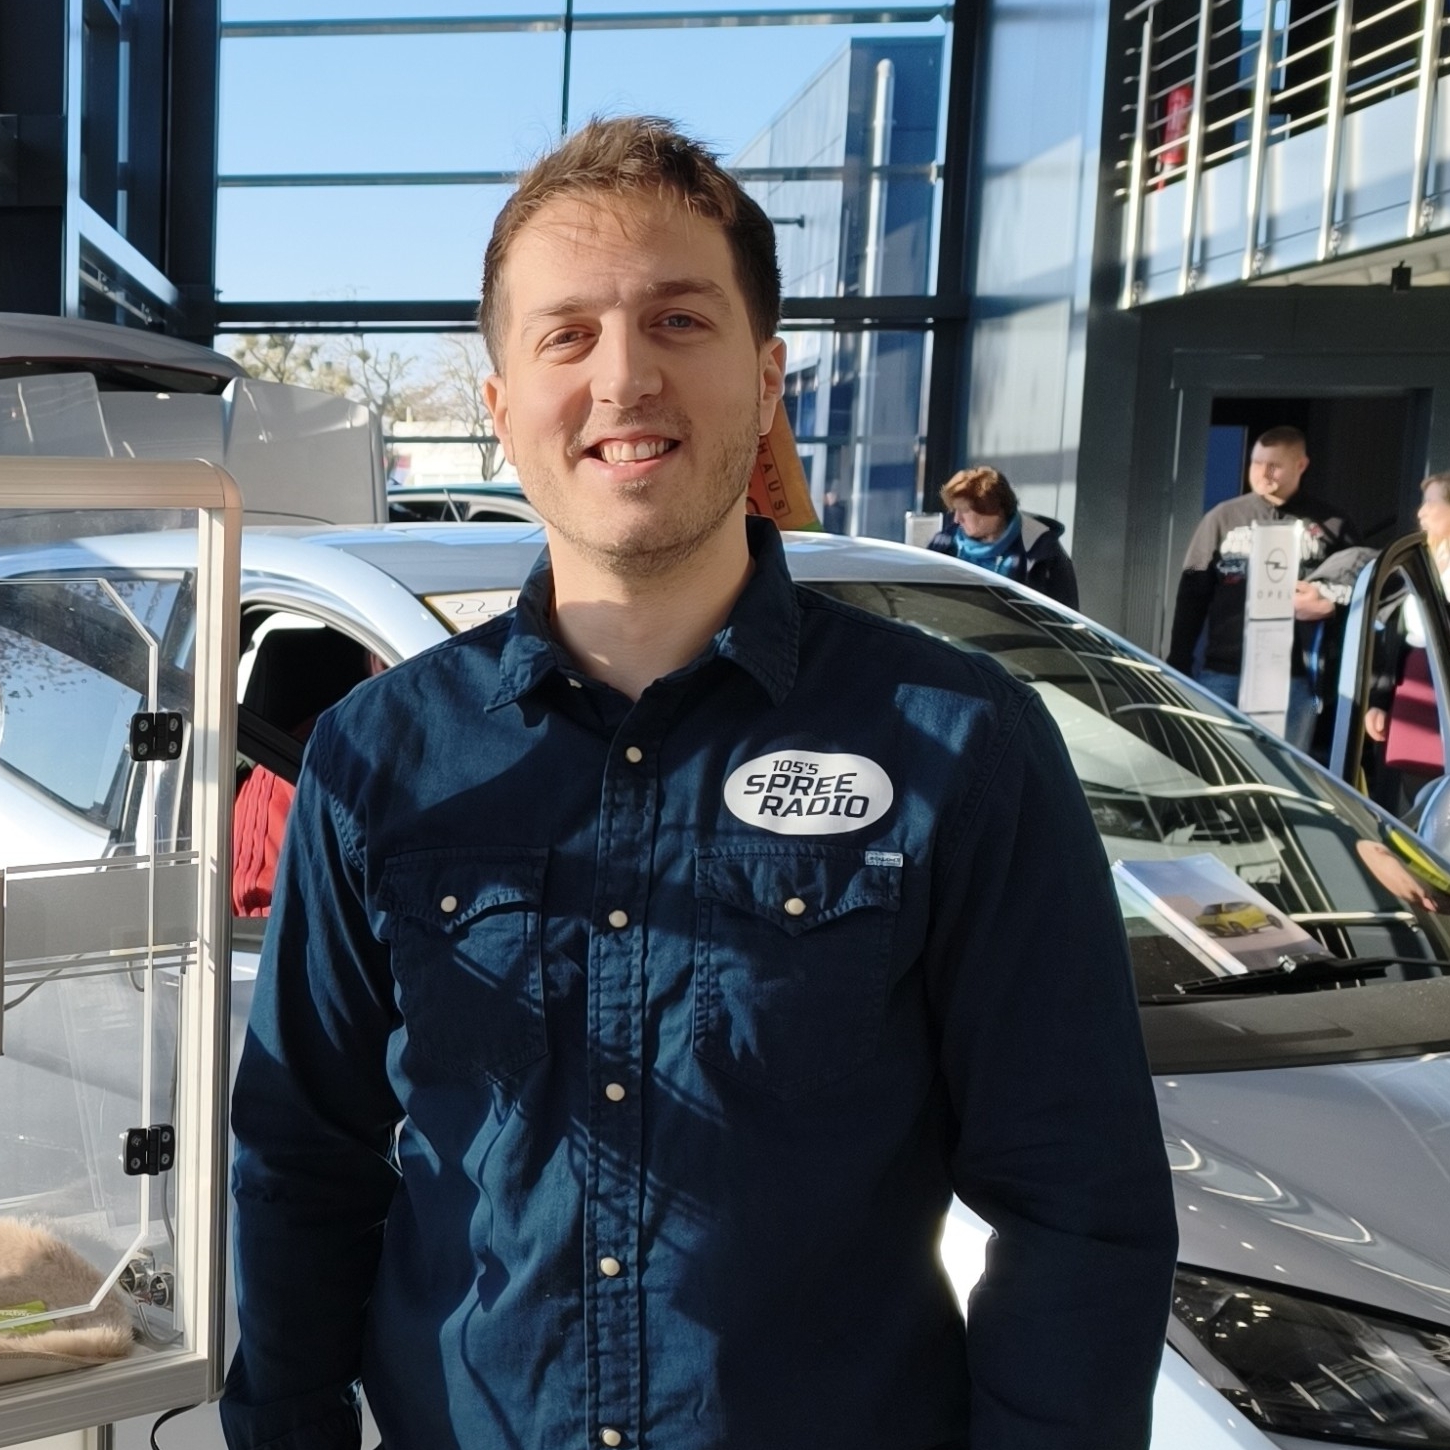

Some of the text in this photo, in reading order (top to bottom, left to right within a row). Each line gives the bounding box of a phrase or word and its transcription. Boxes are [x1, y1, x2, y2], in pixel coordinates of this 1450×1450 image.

[1256, 590, 1291, 600] OPEL
[772, 760, 819, 775] 105'5
[743, 772, 858, 796] SPREE
[758, 795, 870, 818] RADIO
